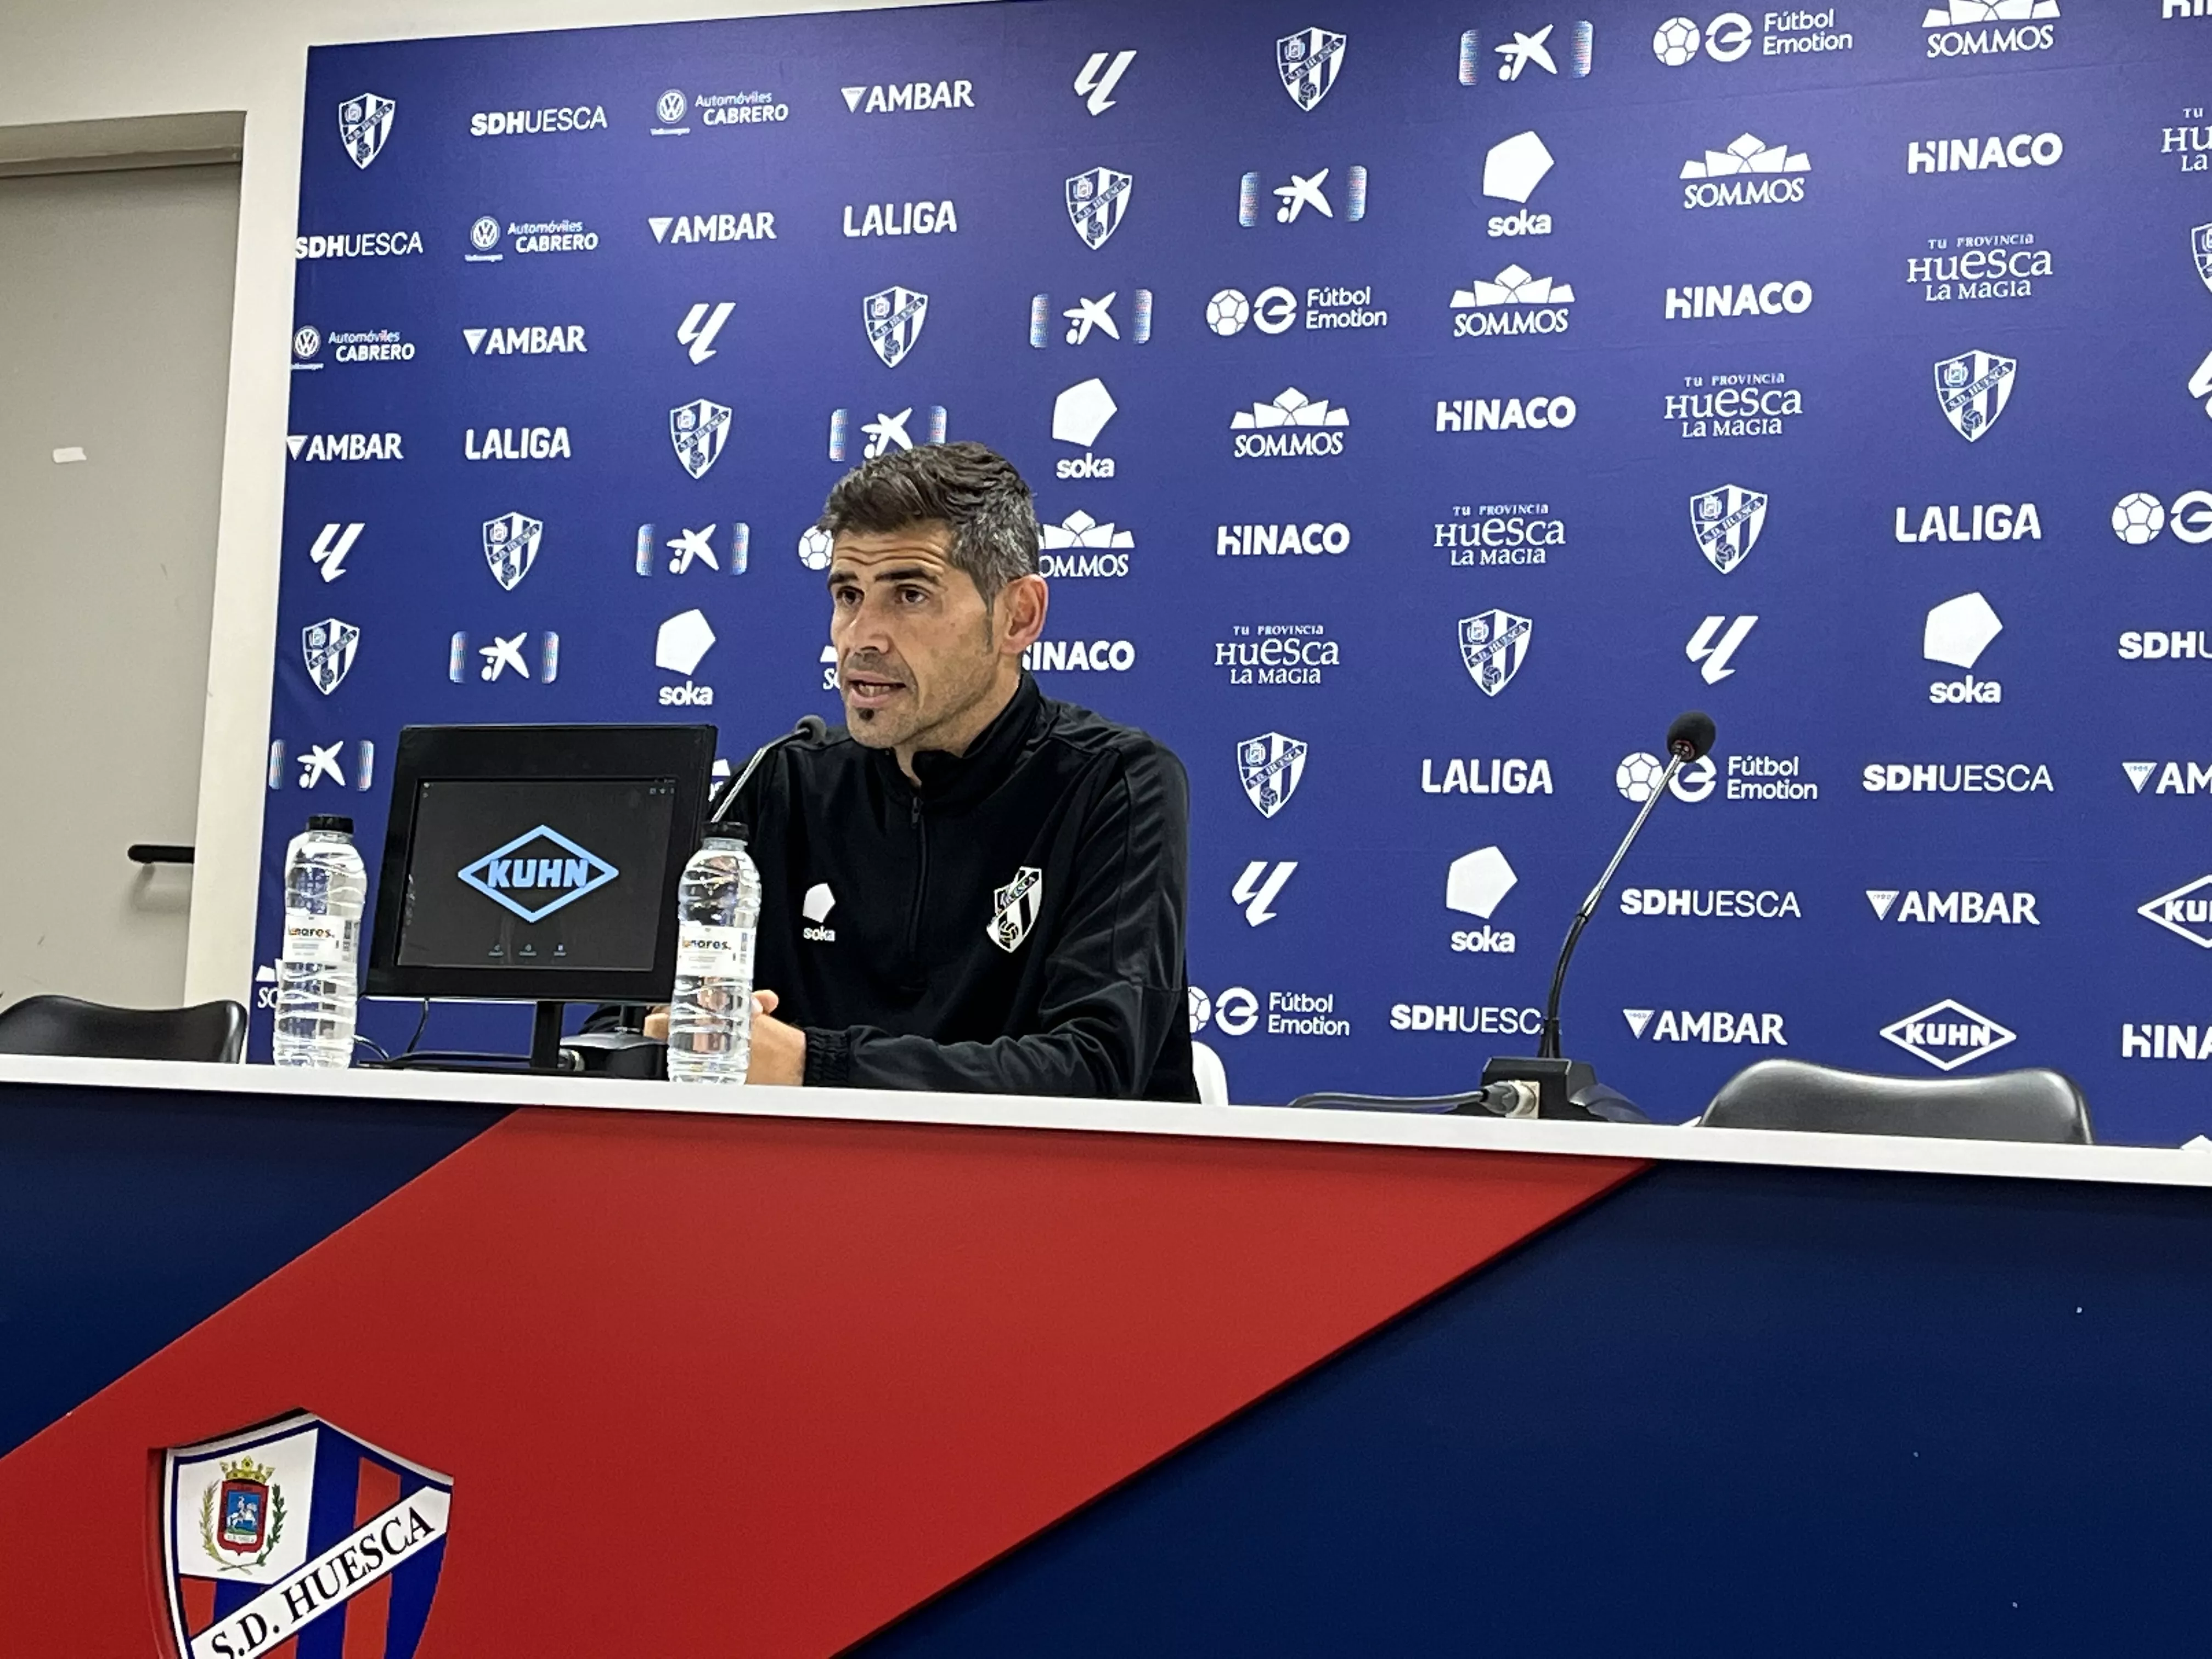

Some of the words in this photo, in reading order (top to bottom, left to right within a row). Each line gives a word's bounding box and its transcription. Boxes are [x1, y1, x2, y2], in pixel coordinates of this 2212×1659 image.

[1764, 8, 1834, 32] Fútbol
[1763, 31, 1853, 55] Emotion
[1926, 24, 2053, 58] SOMMOS
[865, 80, 975, 113] AMBAR
[470, 105, 608, 136] SDHUESCA
[703, 103, 789, 126] CABRERO
[1908, 132, 2063, 174] HINACO
[1684, 177, 1805, 209] SOMMOS
[670, 212, 777, 244] AMBAR
[843, 200, 957, 237] LALIGA
[1487, 208, 1551, 237] soka
[296, 231, 423, 258] SDHUESCA
[516, 233, 599, 253] CABRERO
[1307, 286, 1371, 308] Fútbol
[1665, 280, 1812, 319] HINACO
[1306, 307, 1387, 329] Emotion
[1453, 308, 1568, 337] SOMMOS
[336, 343, 415, 362] CABRERO
[485, 325, 588, 355] AMBAR
[1436, 396, 1576, 432] HINACO
[306, 433, 404, 461] AMBAR
[465, 427, 571, 460] LALIGA
[1234, 432, 1344, 458] SOMMOS
[1056, 452, 1115, 478] soka
[1895, 503, 2041, 543] LALIGA
[1217, 522, 1350, 555] HINACO
[1039, 554, 1129, 577] OMMOS
[659, 680, 713, 706] soka
[1929, 675, 2001, 703] soka
[1421, 759, 1553, 794] LALIGA
[1728, 755, 1799, 776] Fútbol
[1863, 764, 2053, 792] SDHUESCA
[1727, 778, 1818, 799] Emotion
[487, 858, 589, 888] KUHN
[1620, 888, 1801, 918] SDHUESCA
[1897, 890, 2040, 925] AMBAR
[804, 926, 835, 941] soka
[1451, 925, 1515, 953] soka
[1269, 992, 1333, 1013] Fútbol
[1268, 1014, 1350, 1036] Emotion
[1390, 1004, 1541, 1034] SDHUESC
[1653, 1010, 1787, 1045] AMBAR
[1905, 1022, 1990, 1047] KUHN
[211, 1612, 280, 1659] S.D.
[280, 1505, 436, 1625] HUESCA
